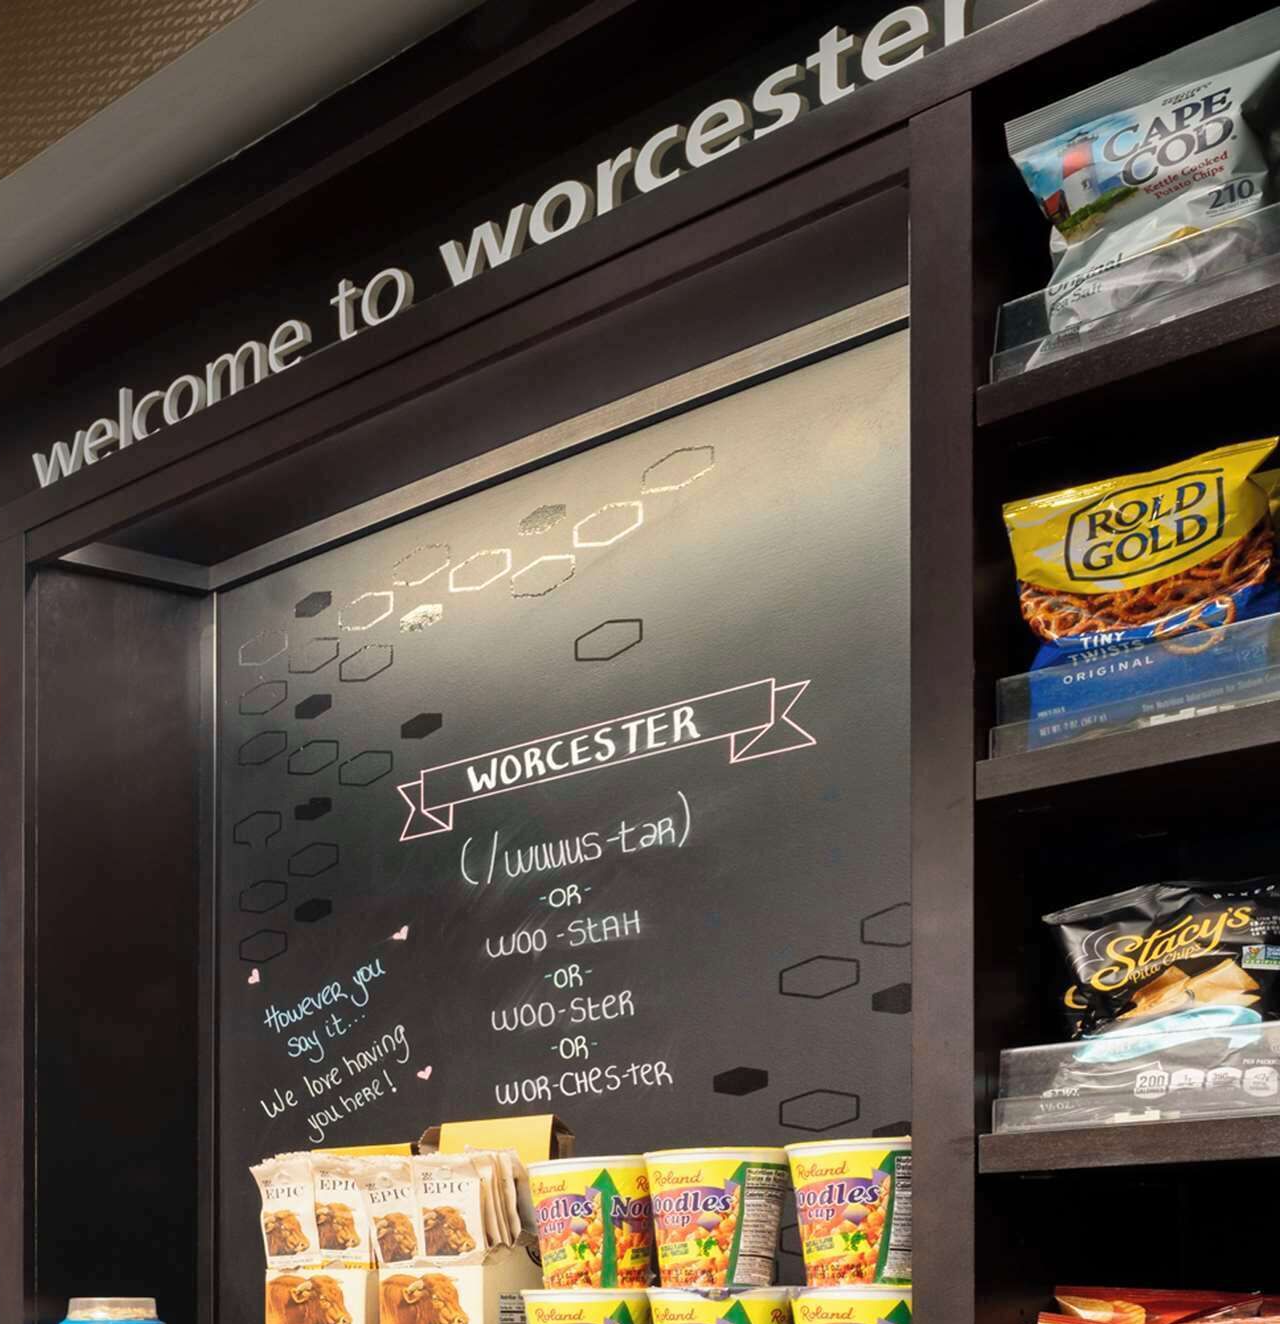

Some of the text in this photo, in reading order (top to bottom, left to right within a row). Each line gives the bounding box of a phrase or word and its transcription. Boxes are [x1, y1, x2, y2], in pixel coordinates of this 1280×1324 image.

[1103, 87, 1233, 164] CAPE
[1121, 115, 1236, 186] COD
[1144, 170, 1180, 195] Kettle
[1154, 163, 1225, 201] Potato Chips
[1209, 179, 1254, 209] 210
[33, 316, 309, 488] welcome
[331, 265, 413, 341] to
[1086, 481, 1207, 541] ROLD
[1082, 514, 1208, 571] GOLD
[1067, 640, 1145, 667] TWISTS
[1080, 630, 1127, 650] TINY
[1063, 656, 1154, 686] ORIGINAL
[467, 705, 701, 794] WORCESTER
[1090, 906, 1254, 992] Stacy's
[351, 959, 386, 1007] you
[288, 1030, 325, 1063] say
[261, 1024, 410, 1118] We love having
[1139, 1075, 1165, 1088] 200
[307, 1105, 343, 1143] you
[654, 1170, 703, 1187] Roland
[796, 1161, 849, 1178] Roland
[265, 1185, 304, 1200] EPIC
[370, 1186, 411, 1204] EPIC
[423, 1182, 471, 1194] EPIC
[664, 1214, 690, 1227] cup
[808, 1207, 835, 1221] cup
[535, 1309, 584, 1323] Roland
[800, 1305, 855, 1320] Roland
